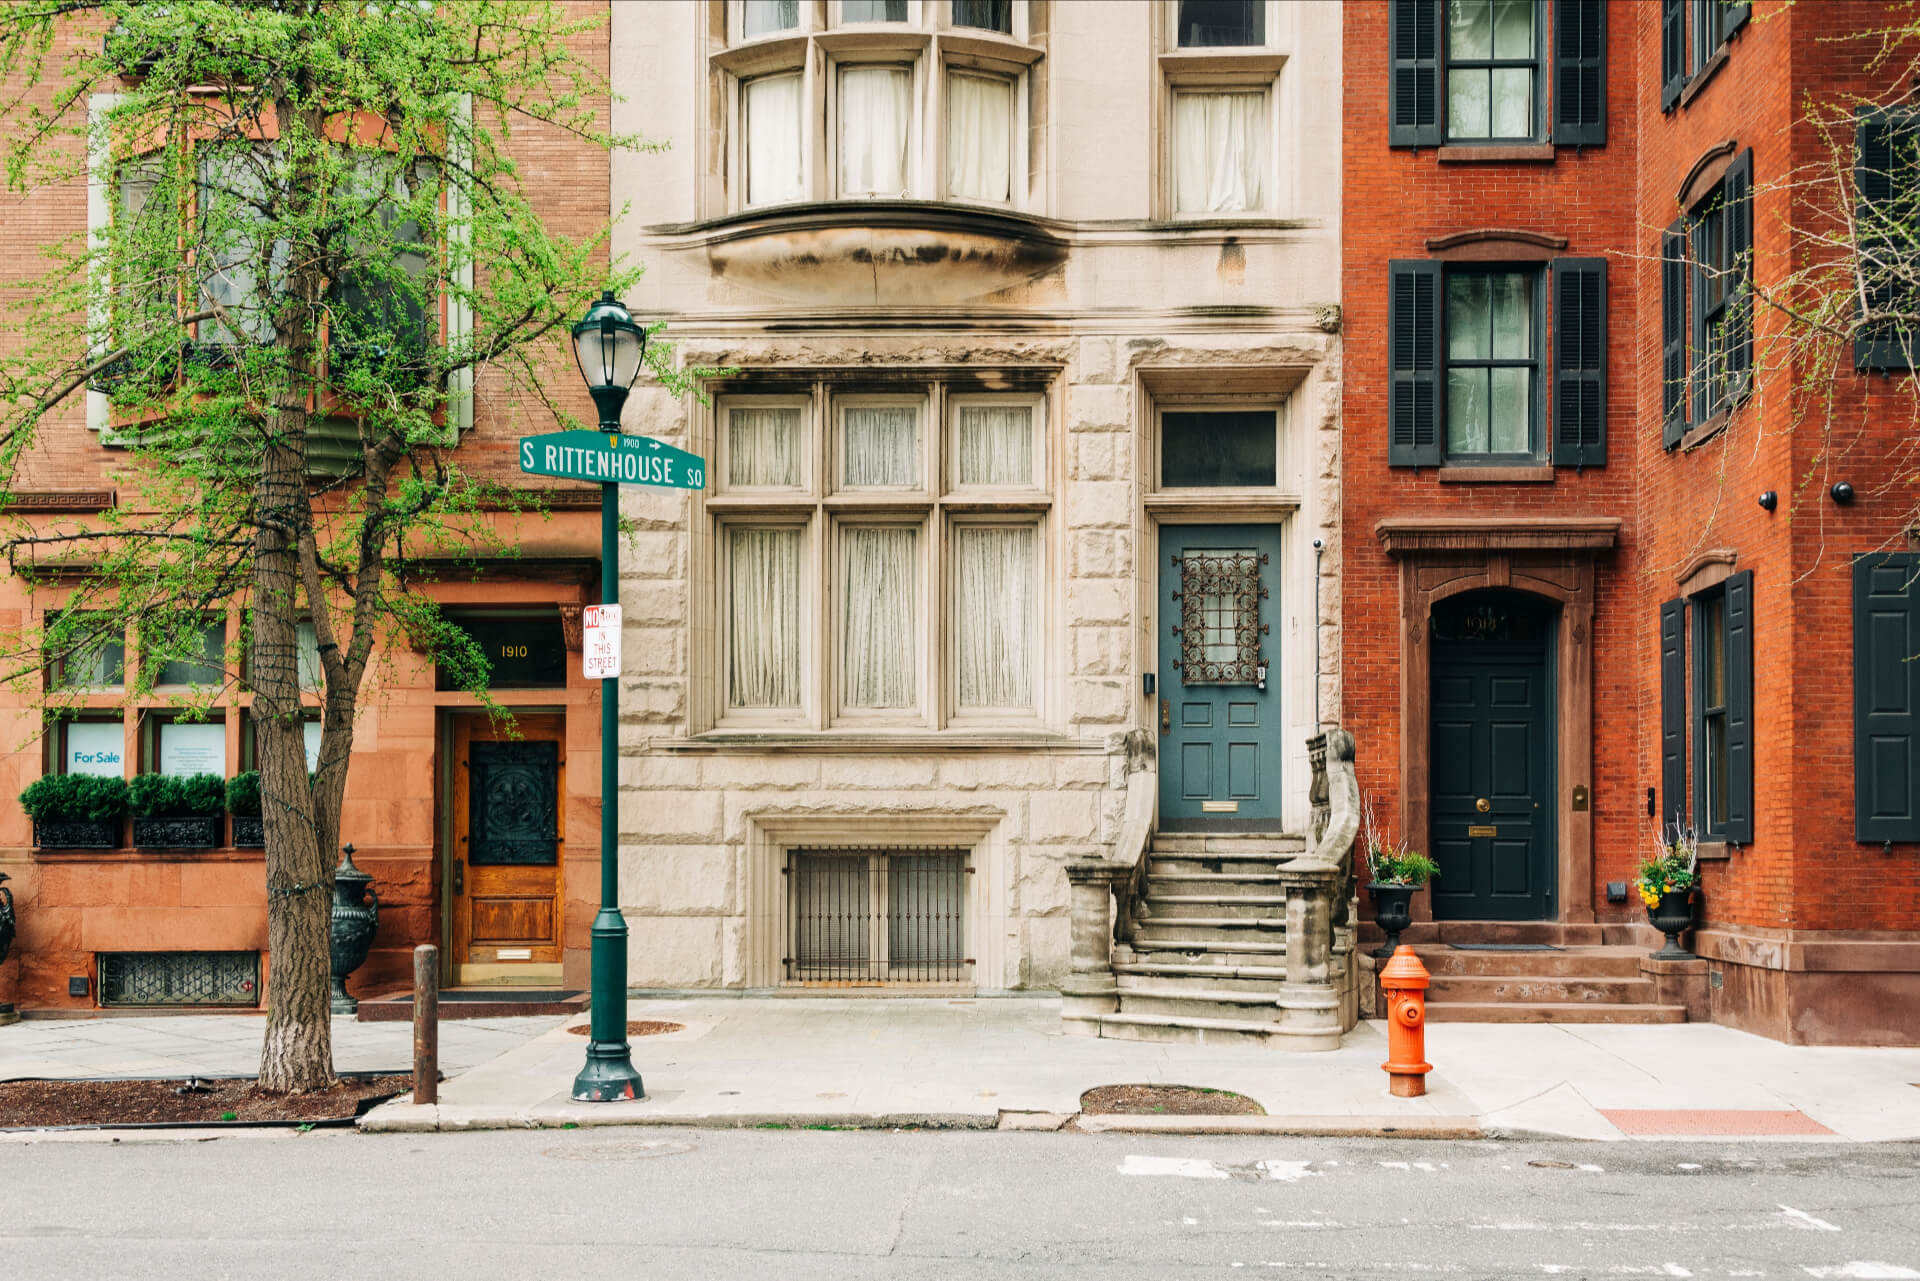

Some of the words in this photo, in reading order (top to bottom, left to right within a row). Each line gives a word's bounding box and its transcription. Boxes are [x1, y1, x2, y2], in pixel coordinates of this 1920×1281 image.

[623, 438, 640, 449] 1900
[522, 441, 535, 470] S
[545, 444, 675, 484] RITTENHOUSE
[687, 468, 703, 487] SQ
[586, 610, 599, 626] NO
[599, 632, 607, 641] IN
[502, 645, 528, 657] 1910
[593, 643, 611, 655] THIS
[588, 656, 616, 670] STREET
[74, 751, 95, 764] For
[96, 751, 120, 764] Sale
